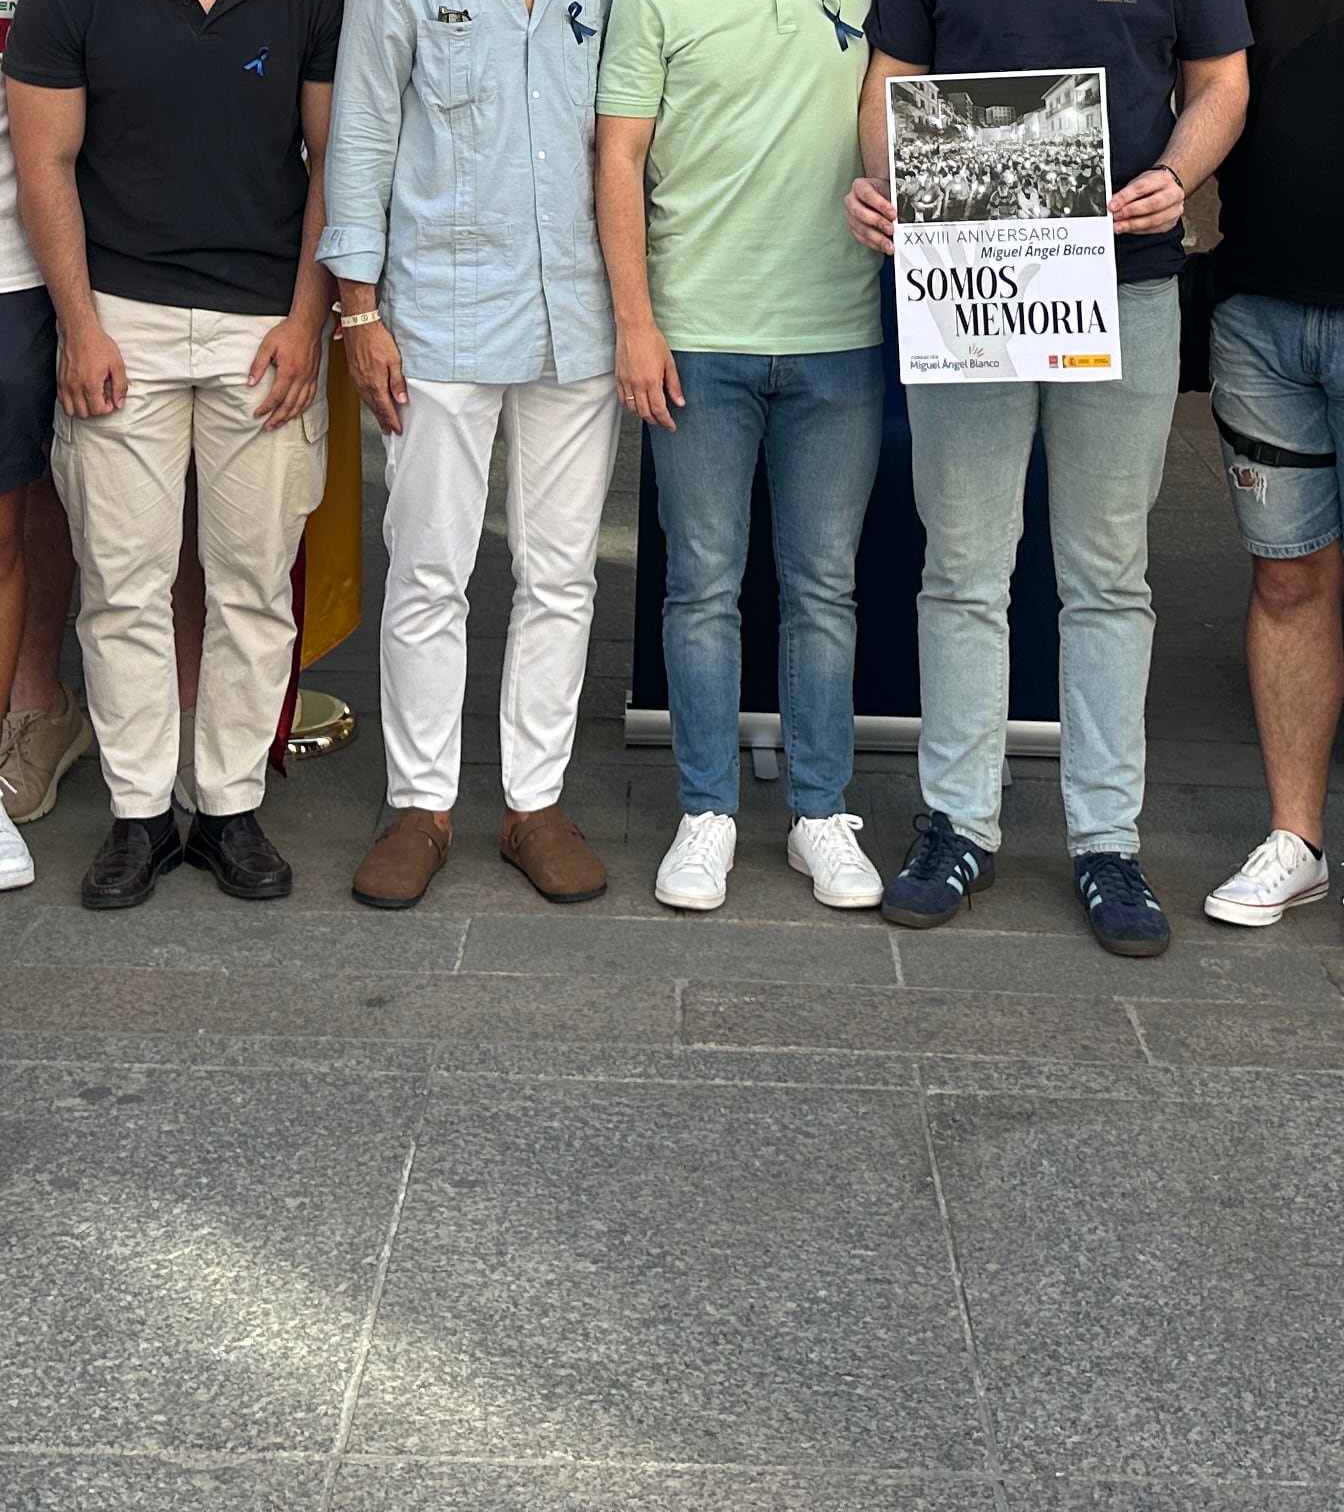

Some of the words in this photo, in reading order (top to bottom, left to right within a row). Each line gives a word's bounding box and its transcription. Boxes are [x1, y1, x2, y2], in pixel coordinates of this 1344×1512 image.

[903, 230, 950, 246] XXVIII
[956, 226, 1069, 244] ANIVERSARIO
[980, 245, 1023, 261] Miguel
[1025, 241, 1060, 260] Ángel
[1063, 243, 1106, 256] Blanco
[906, 265, 1019, 302] SOMOS
[955, 299, 1108, 337] MEMORIA
[910, 359, 941, 372] Miguel
[942, 357, 969, 371] Ángel
[969, 358, 1000, 368] Blanco
